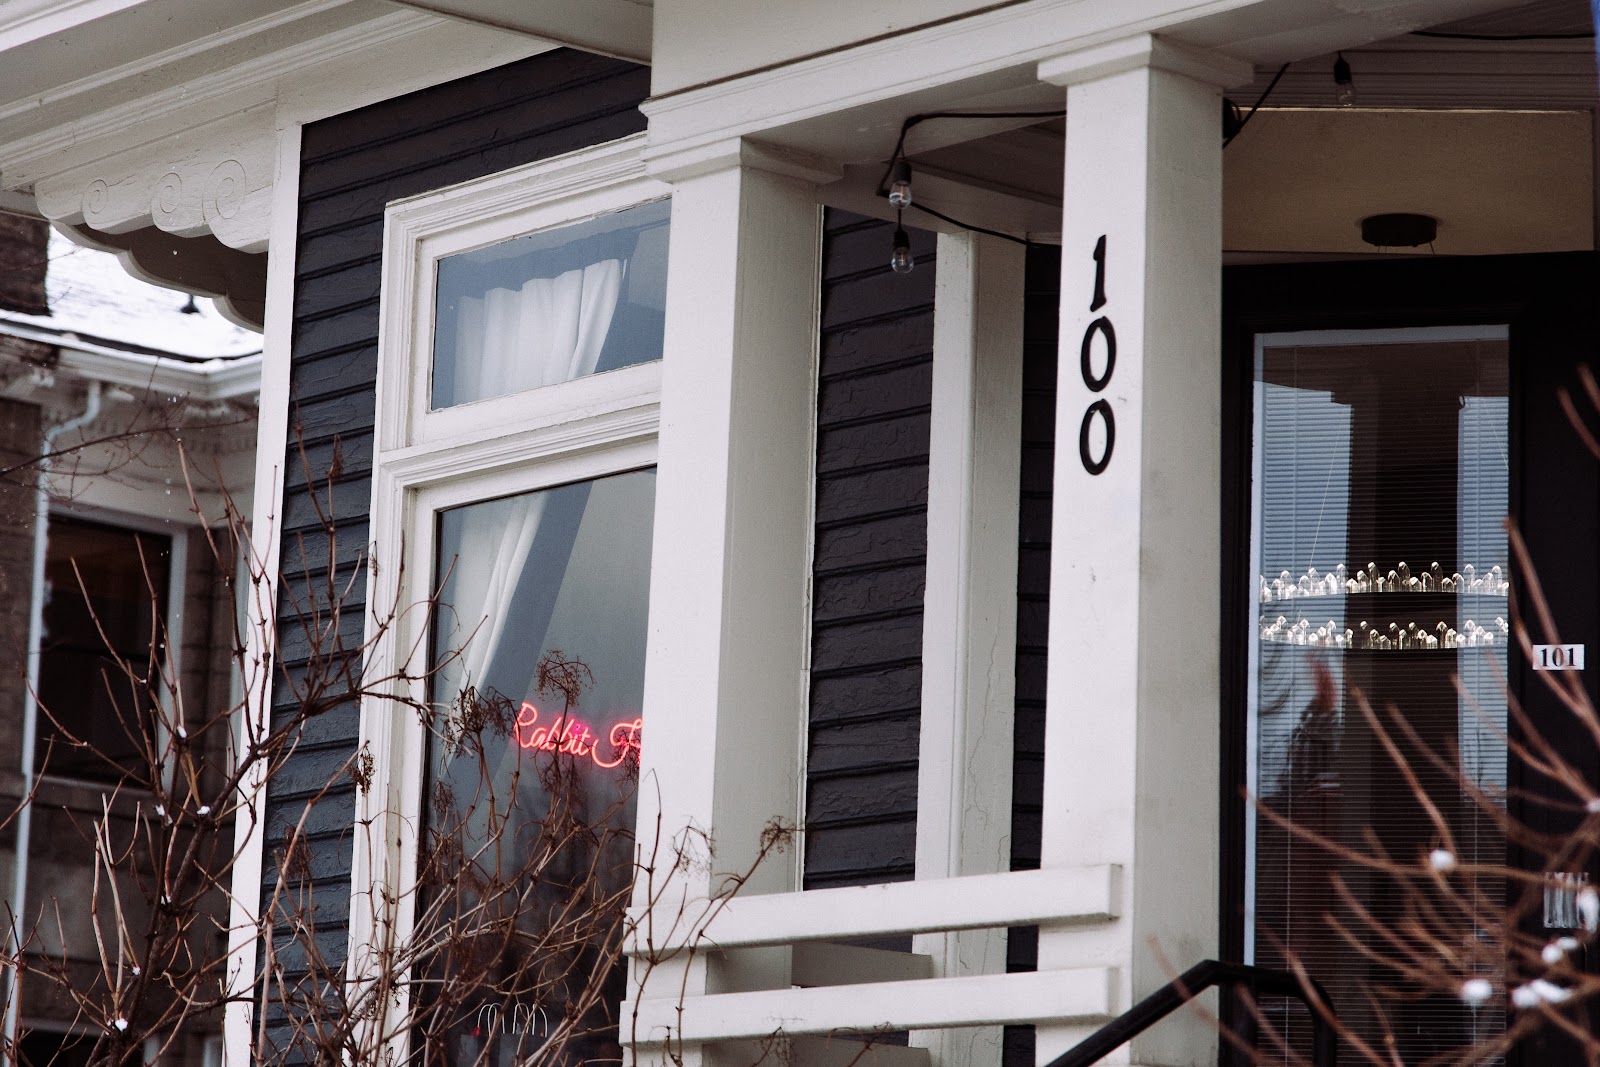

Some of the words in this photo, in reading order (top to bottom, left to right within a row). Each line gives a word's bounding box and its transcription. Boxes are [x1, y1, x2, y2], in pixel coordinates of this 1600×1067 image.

[1079, 233, 1117, 476] 100
[1541, 647, 1576, 667] 101
[514, 702, 591, 756] Rabbit
